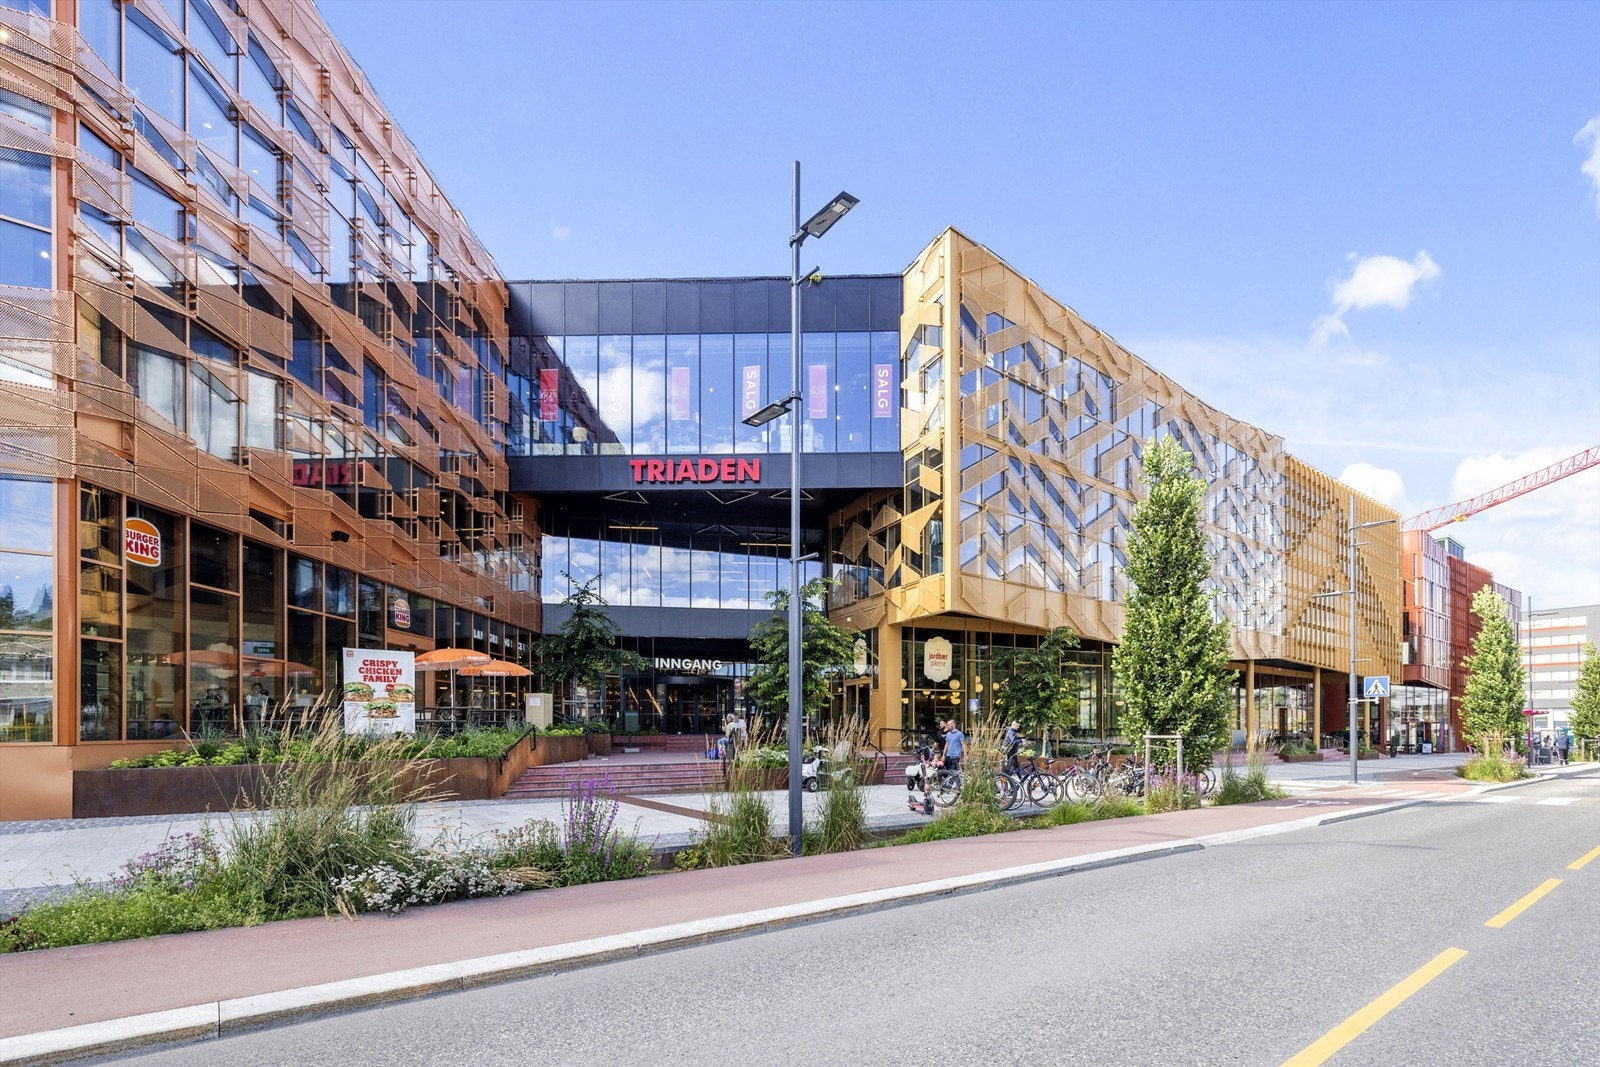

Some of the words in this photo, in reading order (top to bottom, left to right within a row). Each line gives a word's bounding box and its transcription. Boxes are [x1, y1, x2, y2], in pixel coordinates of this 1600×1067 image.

[746, 370, 756, 410] SALG
[878, 369, 888, 409] SALG
[630, 458, 760, 483] TRIADEN
[126, 530, 159, 546] BURGER
[126, 540, 159, 558] KING
[396, 613, 409, 622] KING
[362, 659, 398, 668] CRISPY
[655, 658, 723, 670] INNGANG
[358, 667, 402, 675] CHICKEN
[363, 675, 398, 683] FAMILY
